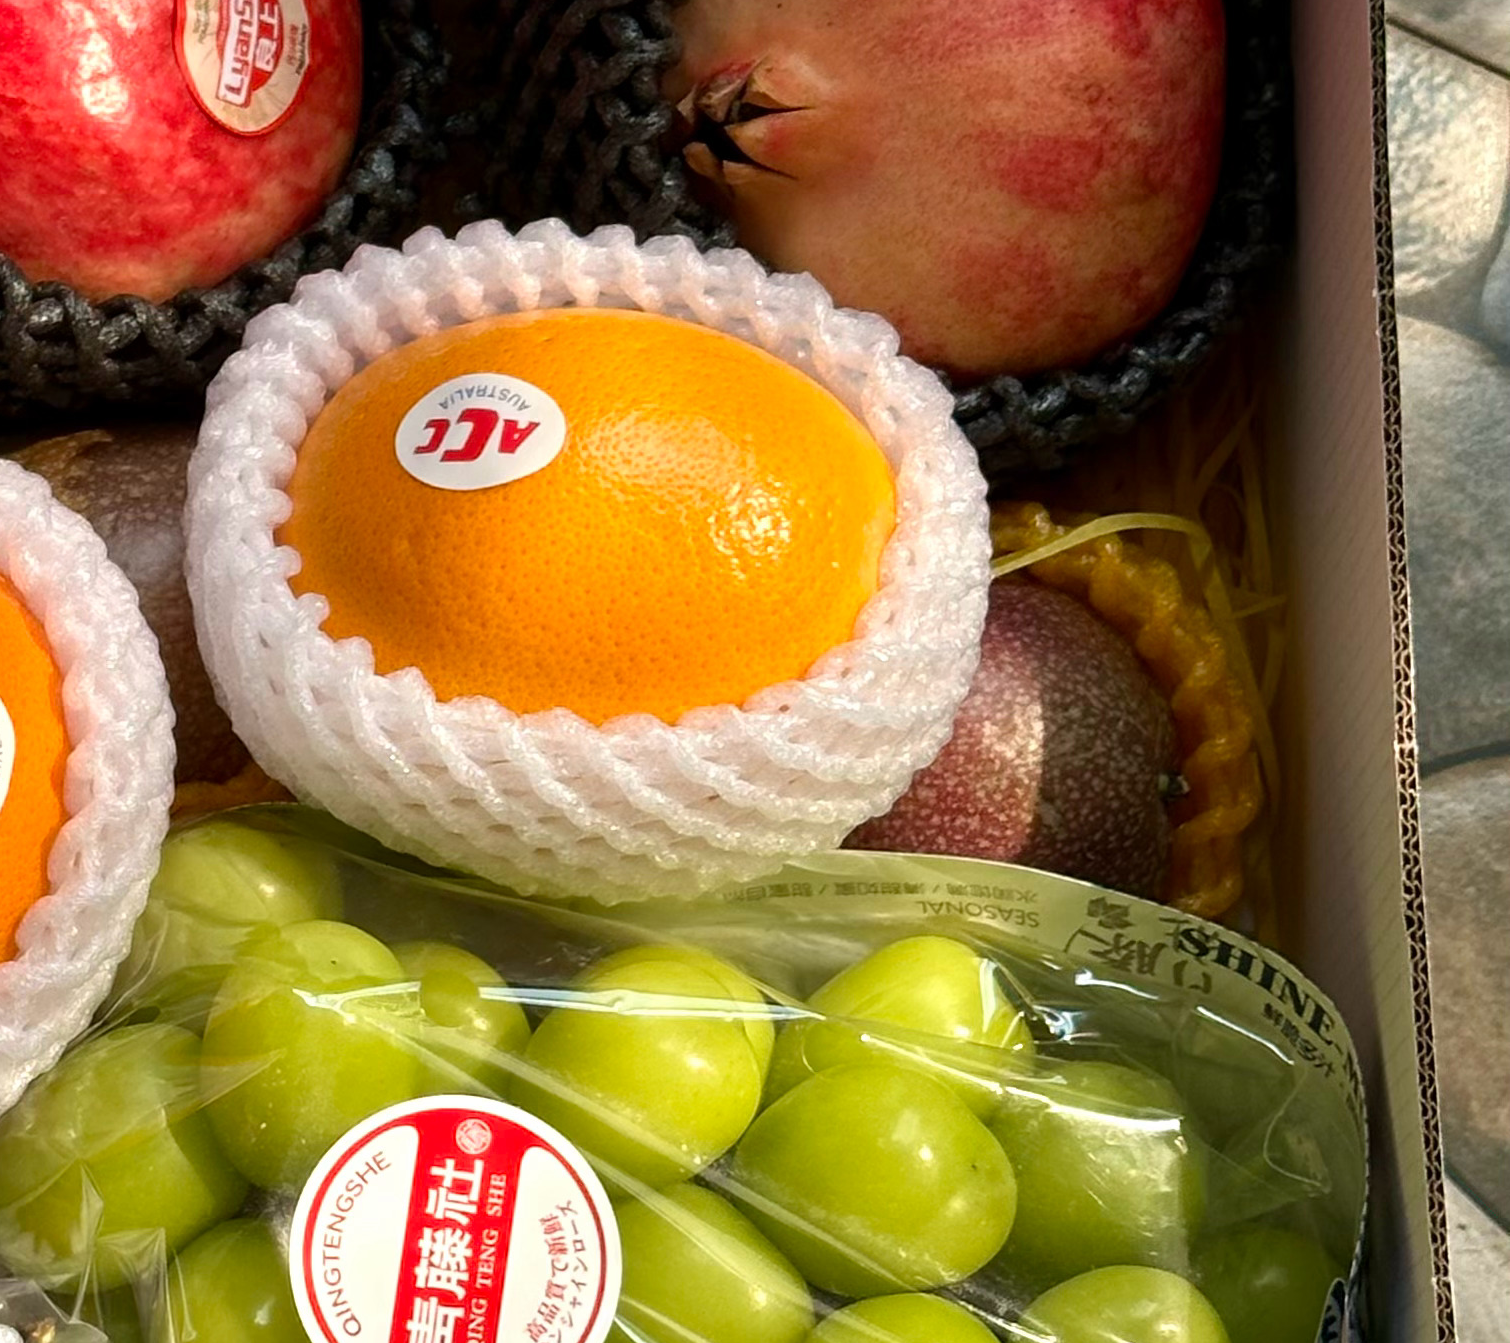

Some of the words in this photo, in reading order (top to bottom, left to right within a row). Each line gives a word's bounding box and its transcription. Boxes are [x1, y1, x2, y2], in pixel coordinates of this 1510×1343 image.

[438, 385, 532, 412] AUSTRALIA
[915, 899, 1041, 929] SEASONAL
[1177, 926, 1336, 1046] SHINE
[486, 1173, 507, 1217] SHE
[322, 1151, 392, 1337] QINGTENGSHE
[475, 1228, 499, 1289] TENG
